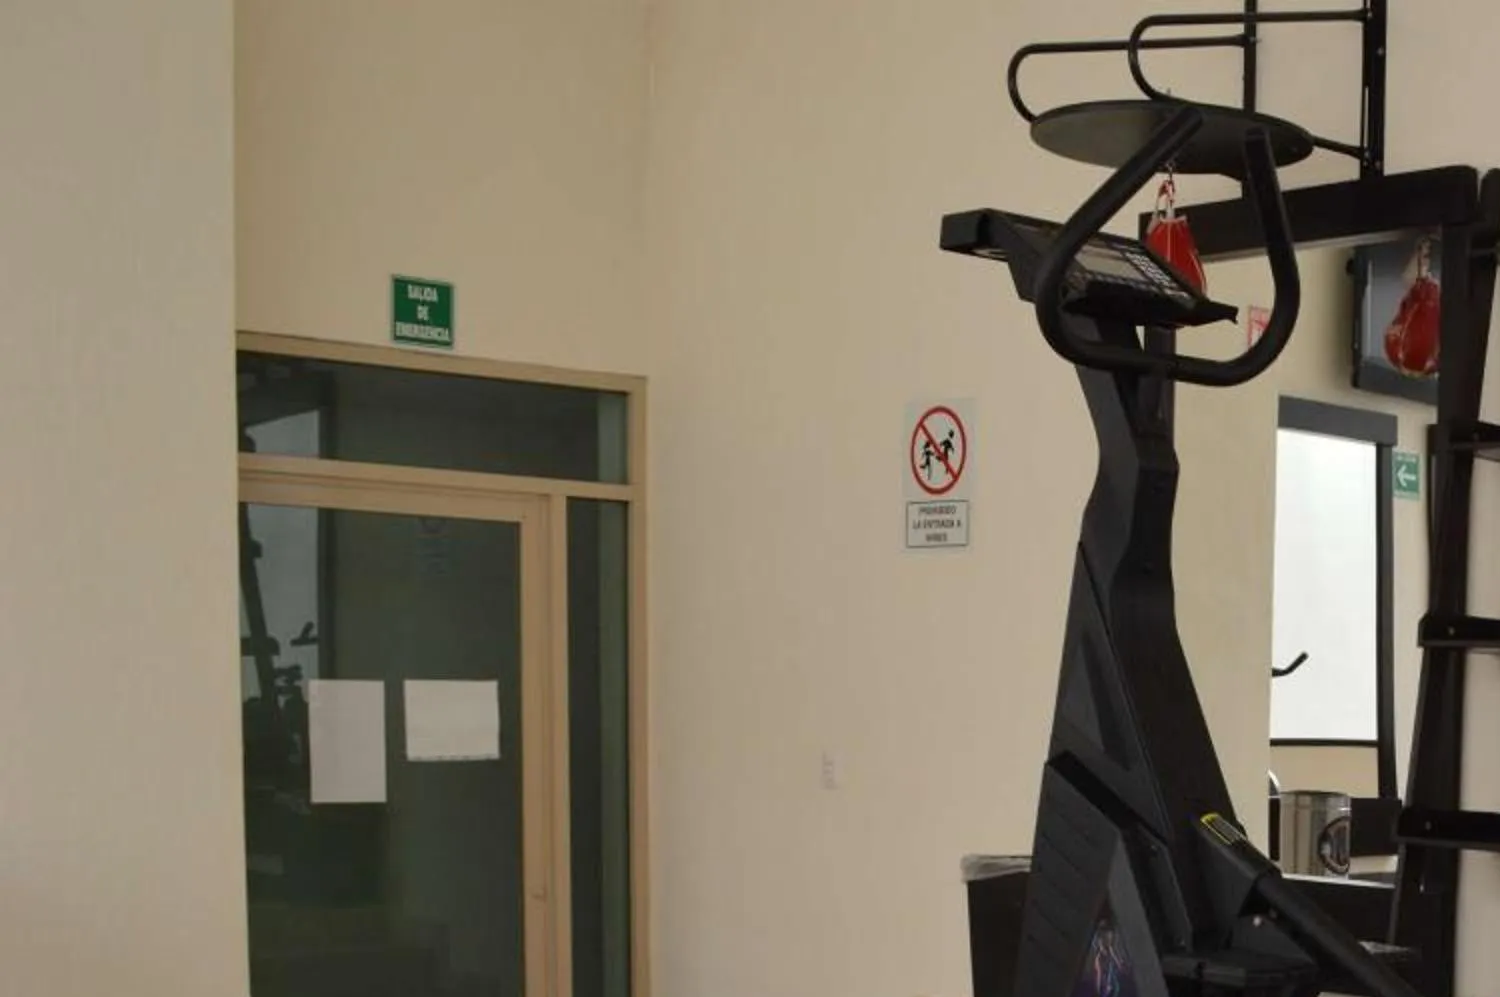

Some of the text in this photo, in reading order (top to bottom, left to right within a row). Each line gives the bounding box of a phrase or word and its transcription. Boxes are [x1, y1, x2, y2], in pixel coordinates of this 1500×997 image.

[408, 284, 438, 302] SALIDA
[417, 305, 428, 321] DE
[396, 321, 450, 341] EMERGENCIA
